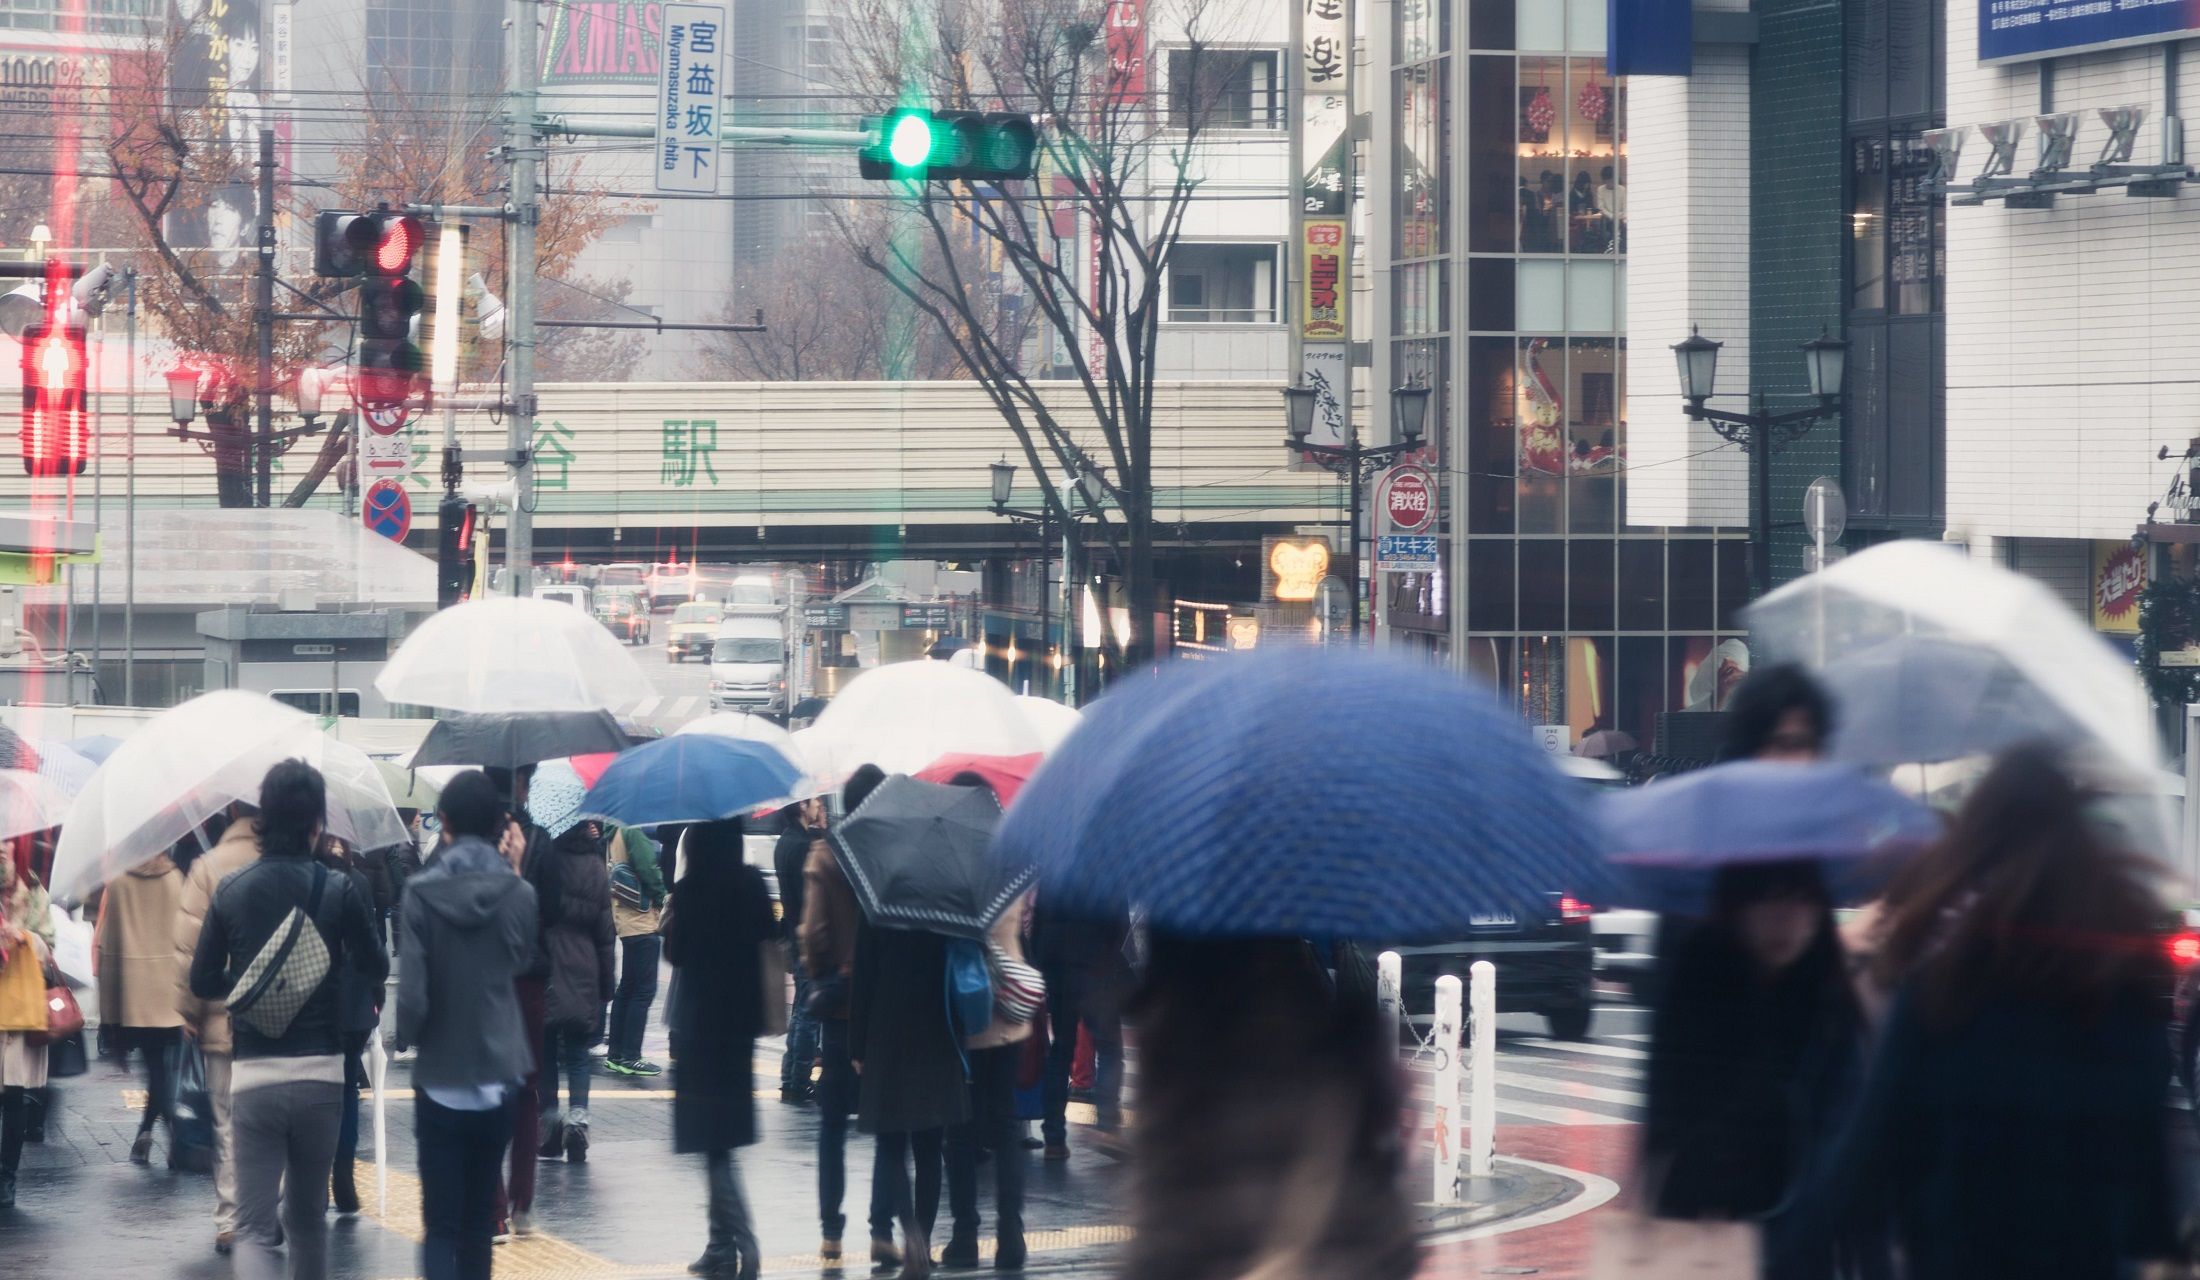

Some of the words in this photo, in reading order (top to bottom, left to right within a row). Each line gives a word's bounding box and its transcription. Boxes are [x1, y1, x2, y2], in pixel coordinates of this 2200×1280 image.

[554, 2, 661, 75] XMAS
[666, 25, 685, 130] Miyamasuzaka
[684, 21, 717, 179] 宮益坂下
[1325, 97, 1343, 109] 2F
[664, 137, 680, 170] shita
[1304, 197, 1324, 211] 2F
[1391, 491, 1427, 511] 消火栓
